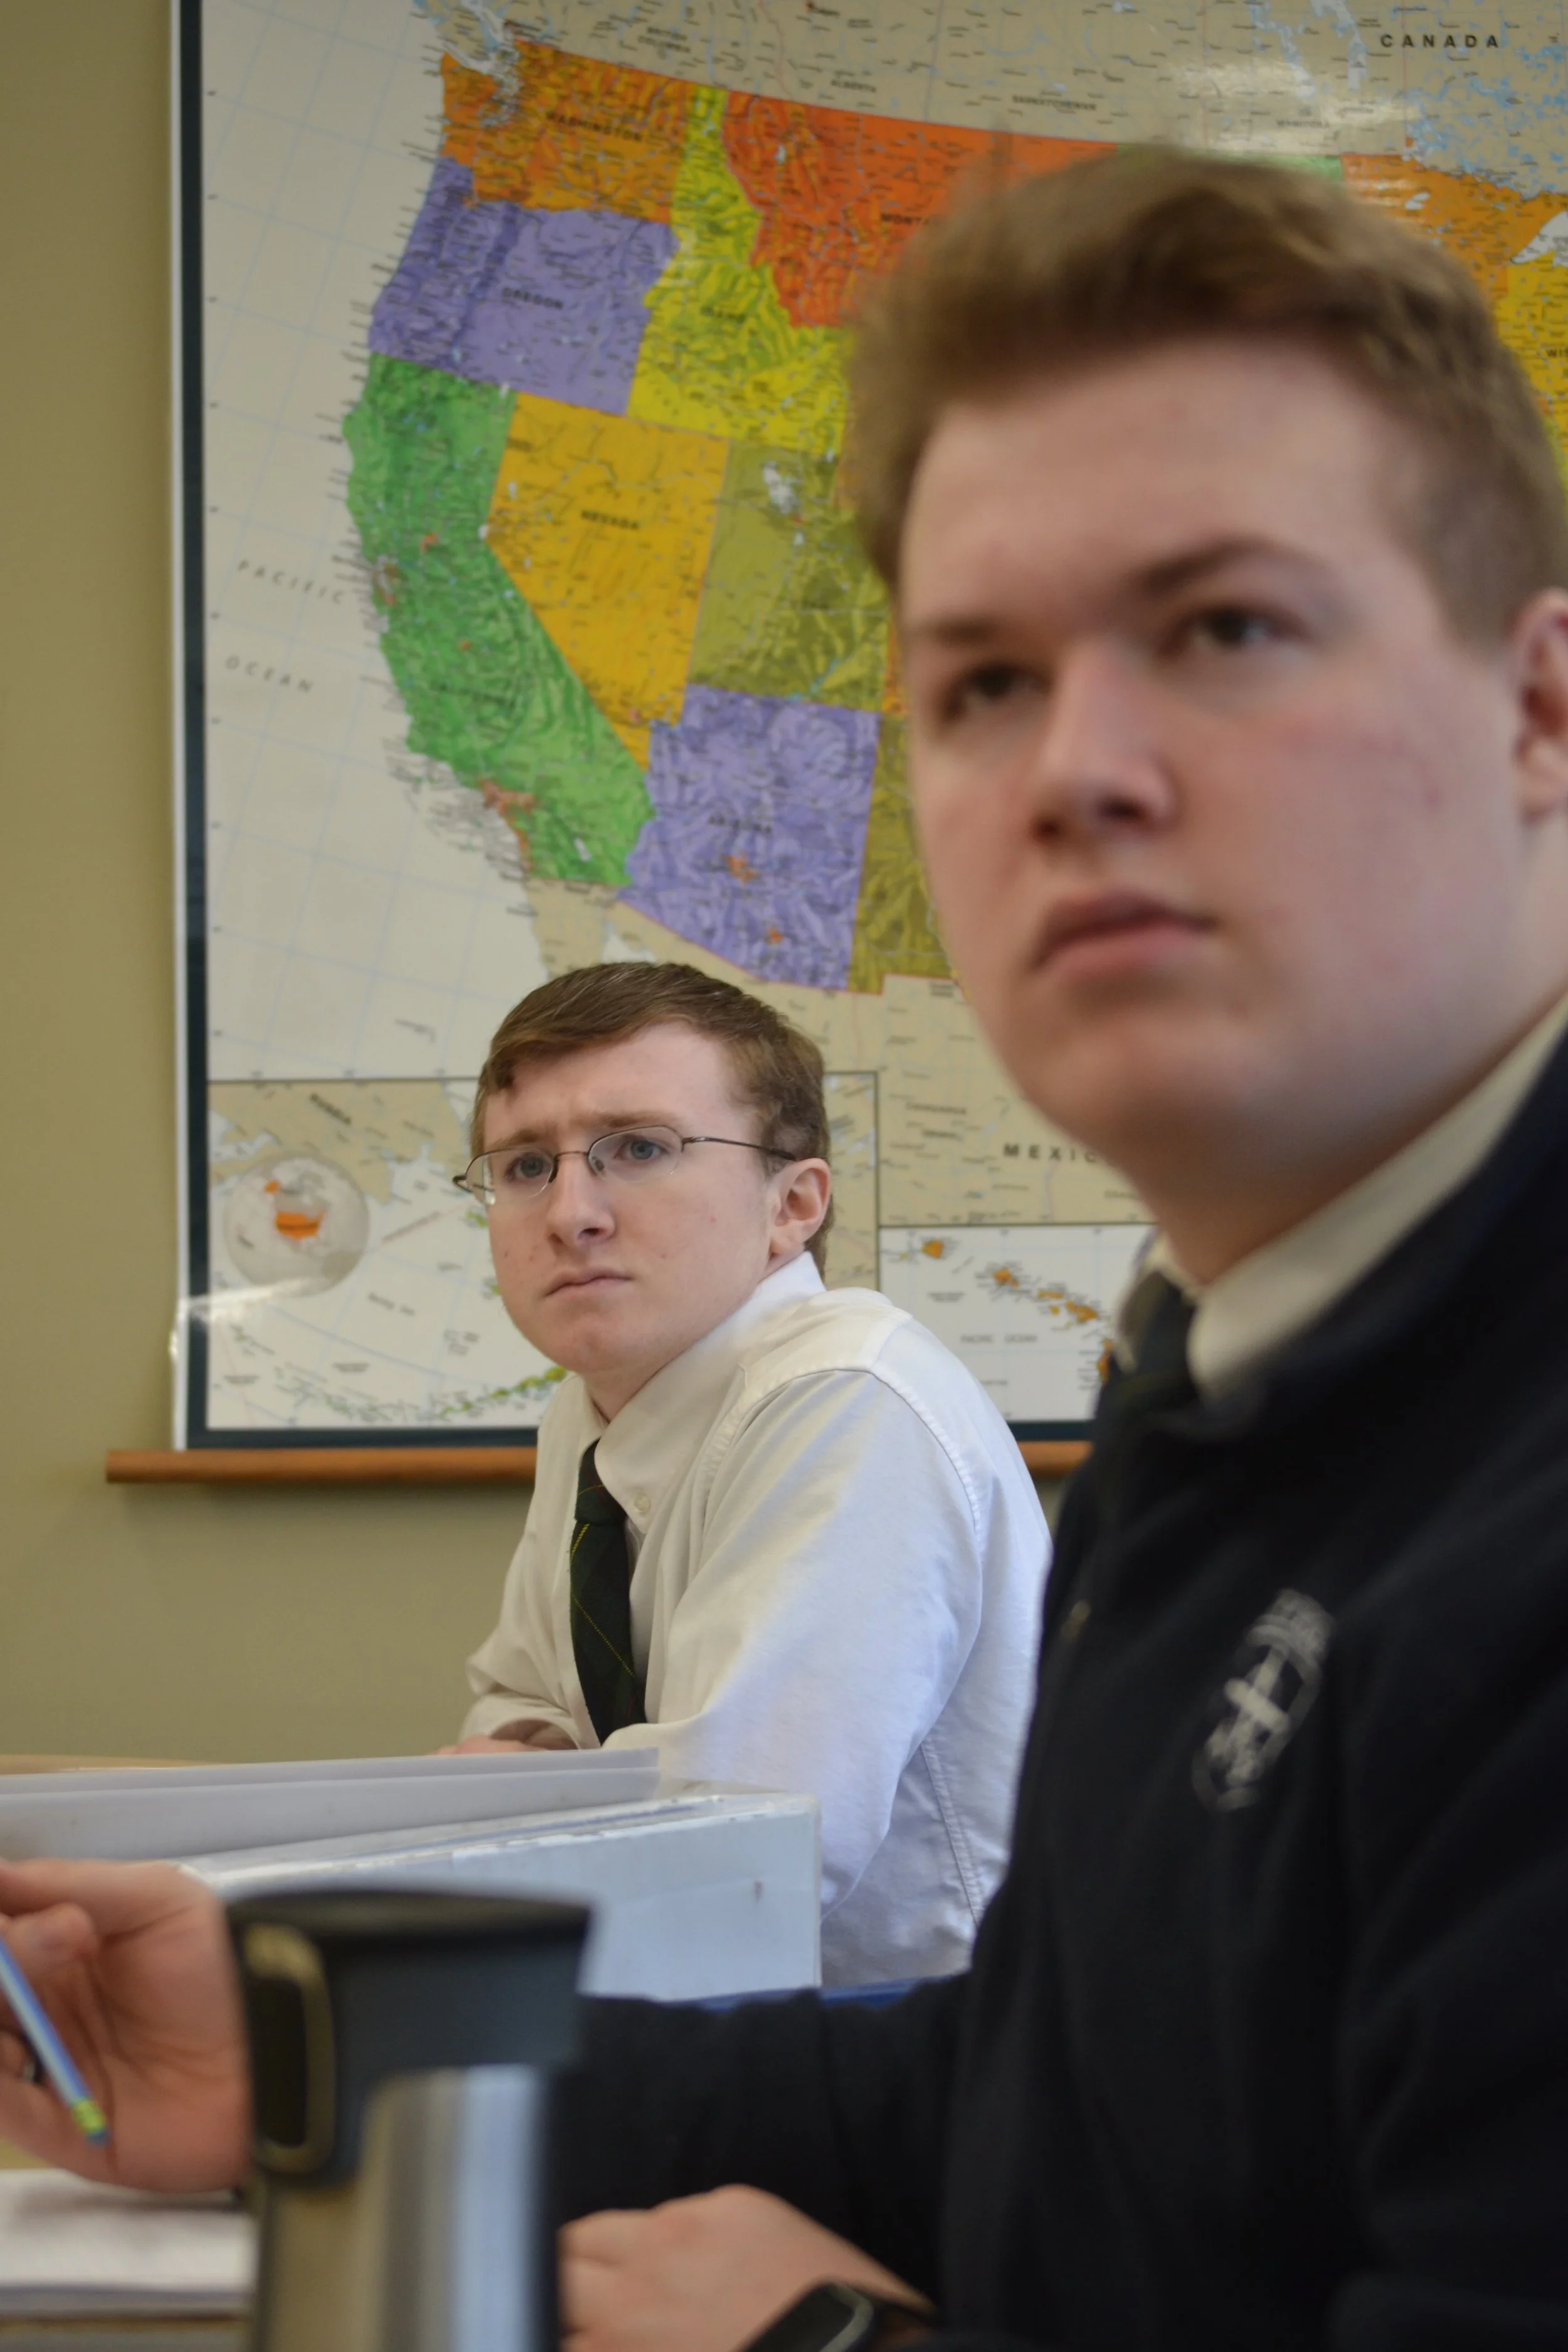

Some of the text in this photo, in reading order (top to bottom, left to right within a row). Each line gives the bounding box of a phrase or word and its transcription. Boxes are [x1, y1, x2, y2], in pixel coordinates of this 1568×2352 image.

[1380, 34, 1498, 48] CANADA
[502, 287, 564, 310] OREGON
[581, 509, 640, 531] NEVADA
[238, 559, 344, 605] PACIFIC
[225, 655, 313, 693] OCEAN
[1004, 1143, 1098, 1162] MEXIC
